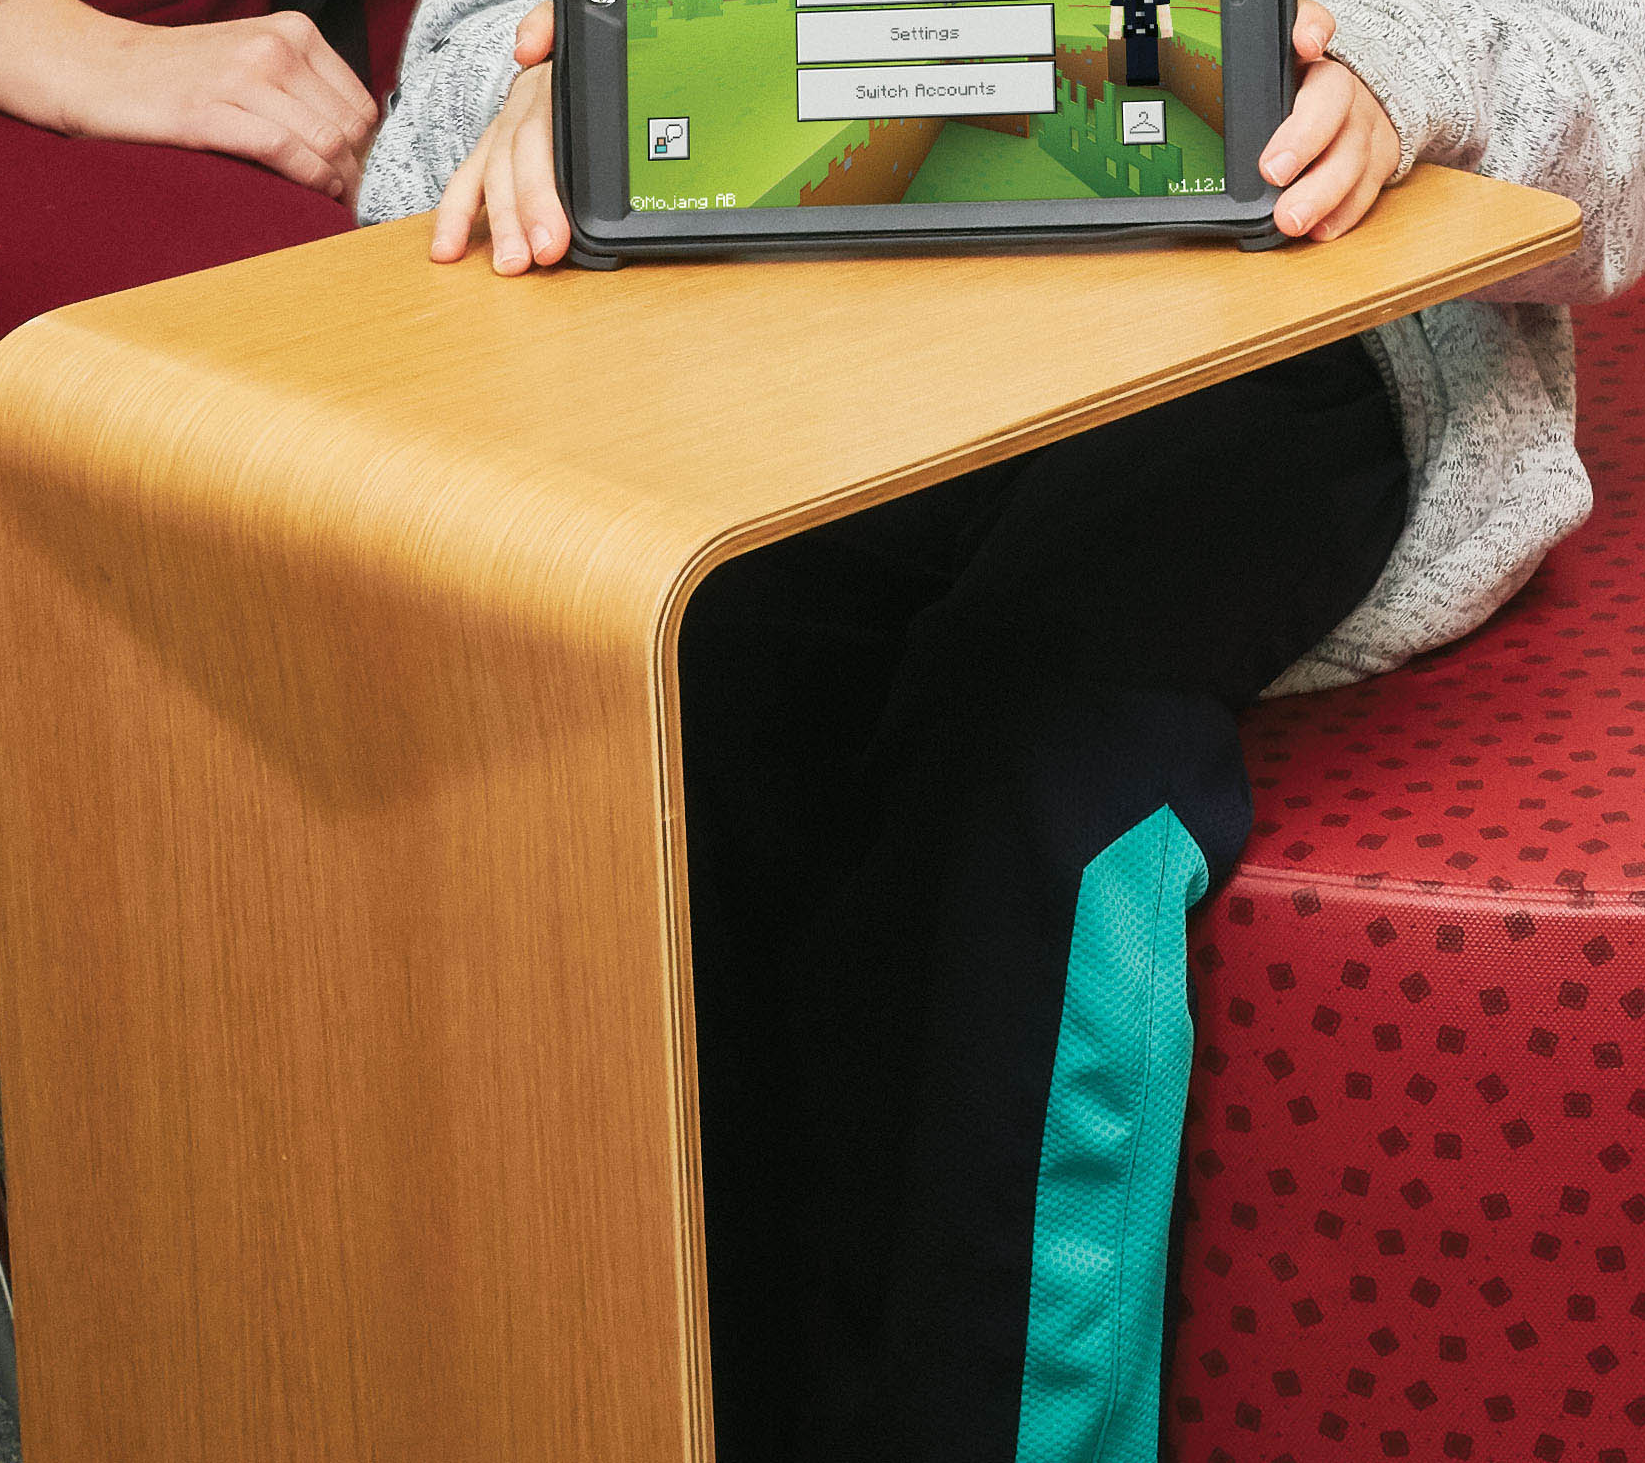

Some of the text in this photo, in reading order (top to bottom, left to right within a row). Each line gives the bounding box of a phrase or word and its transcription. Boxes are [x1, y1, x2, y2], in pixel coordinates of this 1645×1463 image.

[889, 25, 960, 44] Settings
[855, 80, 997, 101] Switch Accounts
[716, 192, 736, 208] AB
